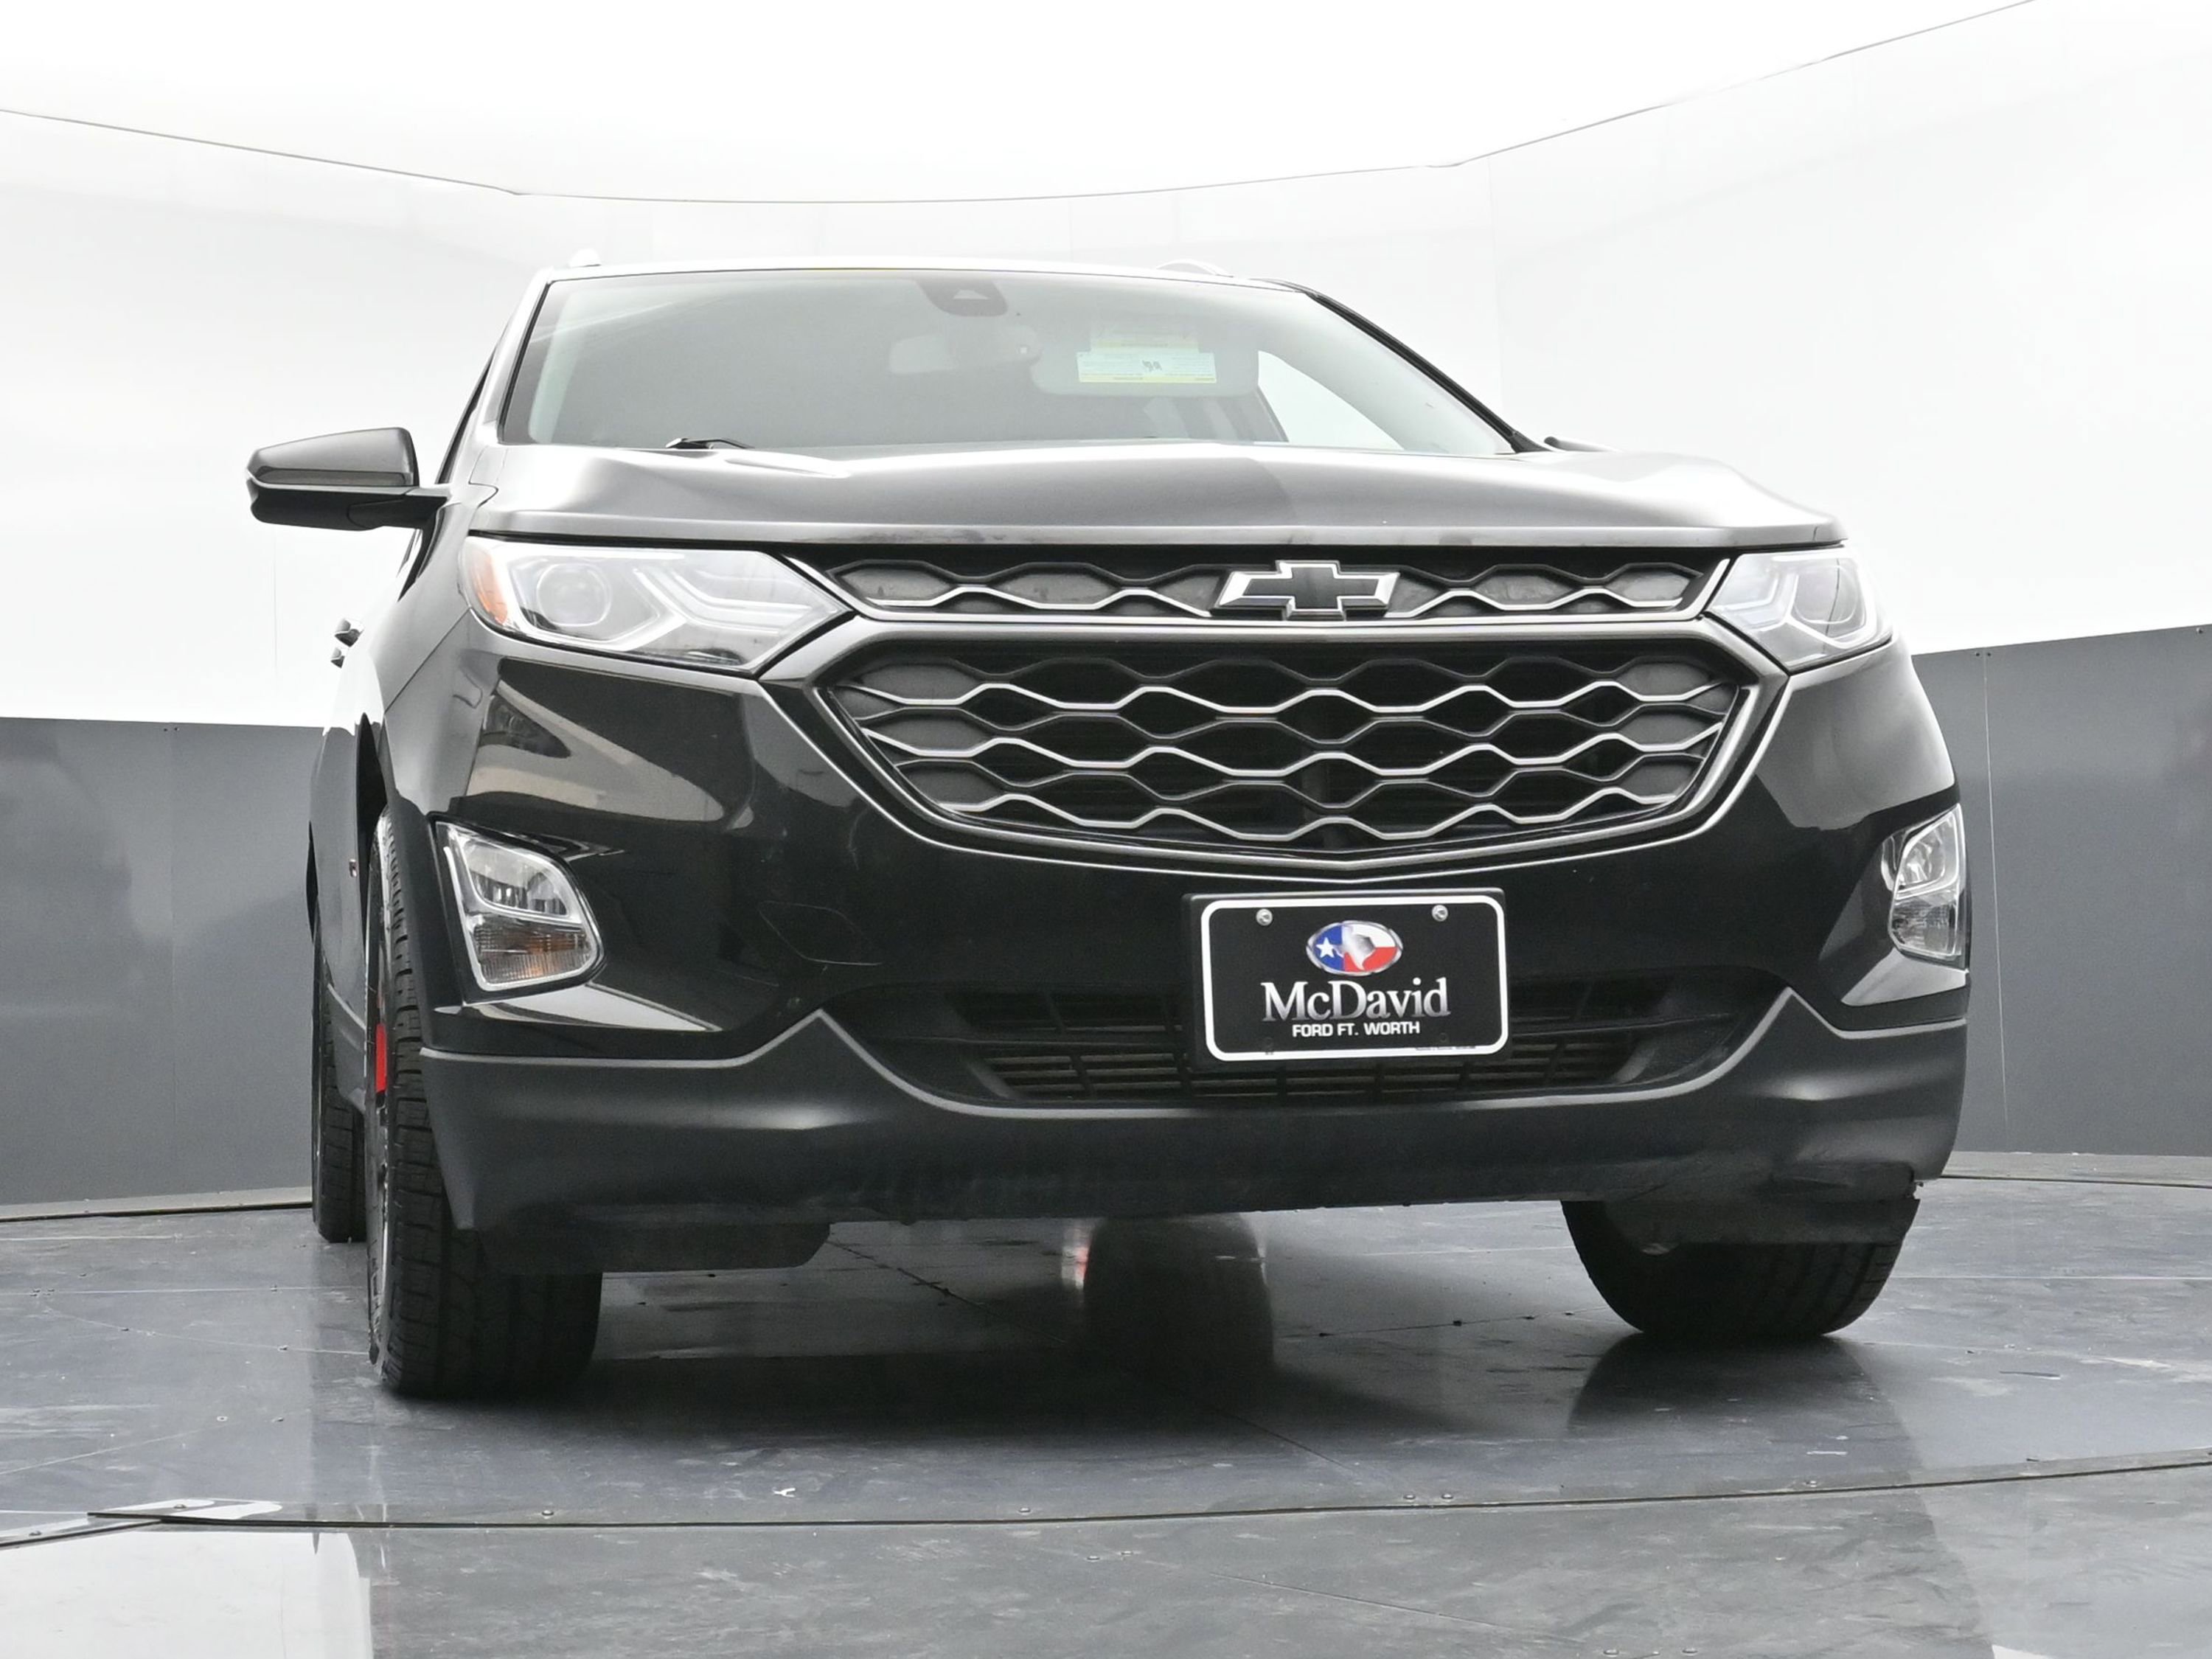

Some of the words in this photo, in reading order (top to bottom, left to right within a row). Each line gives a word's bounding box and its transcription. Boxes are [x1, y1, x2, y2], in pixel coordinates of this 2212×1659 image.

[1260, 977, 1451, 1022] McDavid
[1292, 1023, 1333, 1037] FORD
[1337, 1023, 1359, 1036] FT.
[1363, 1020, 1420, 1036] WORTH
